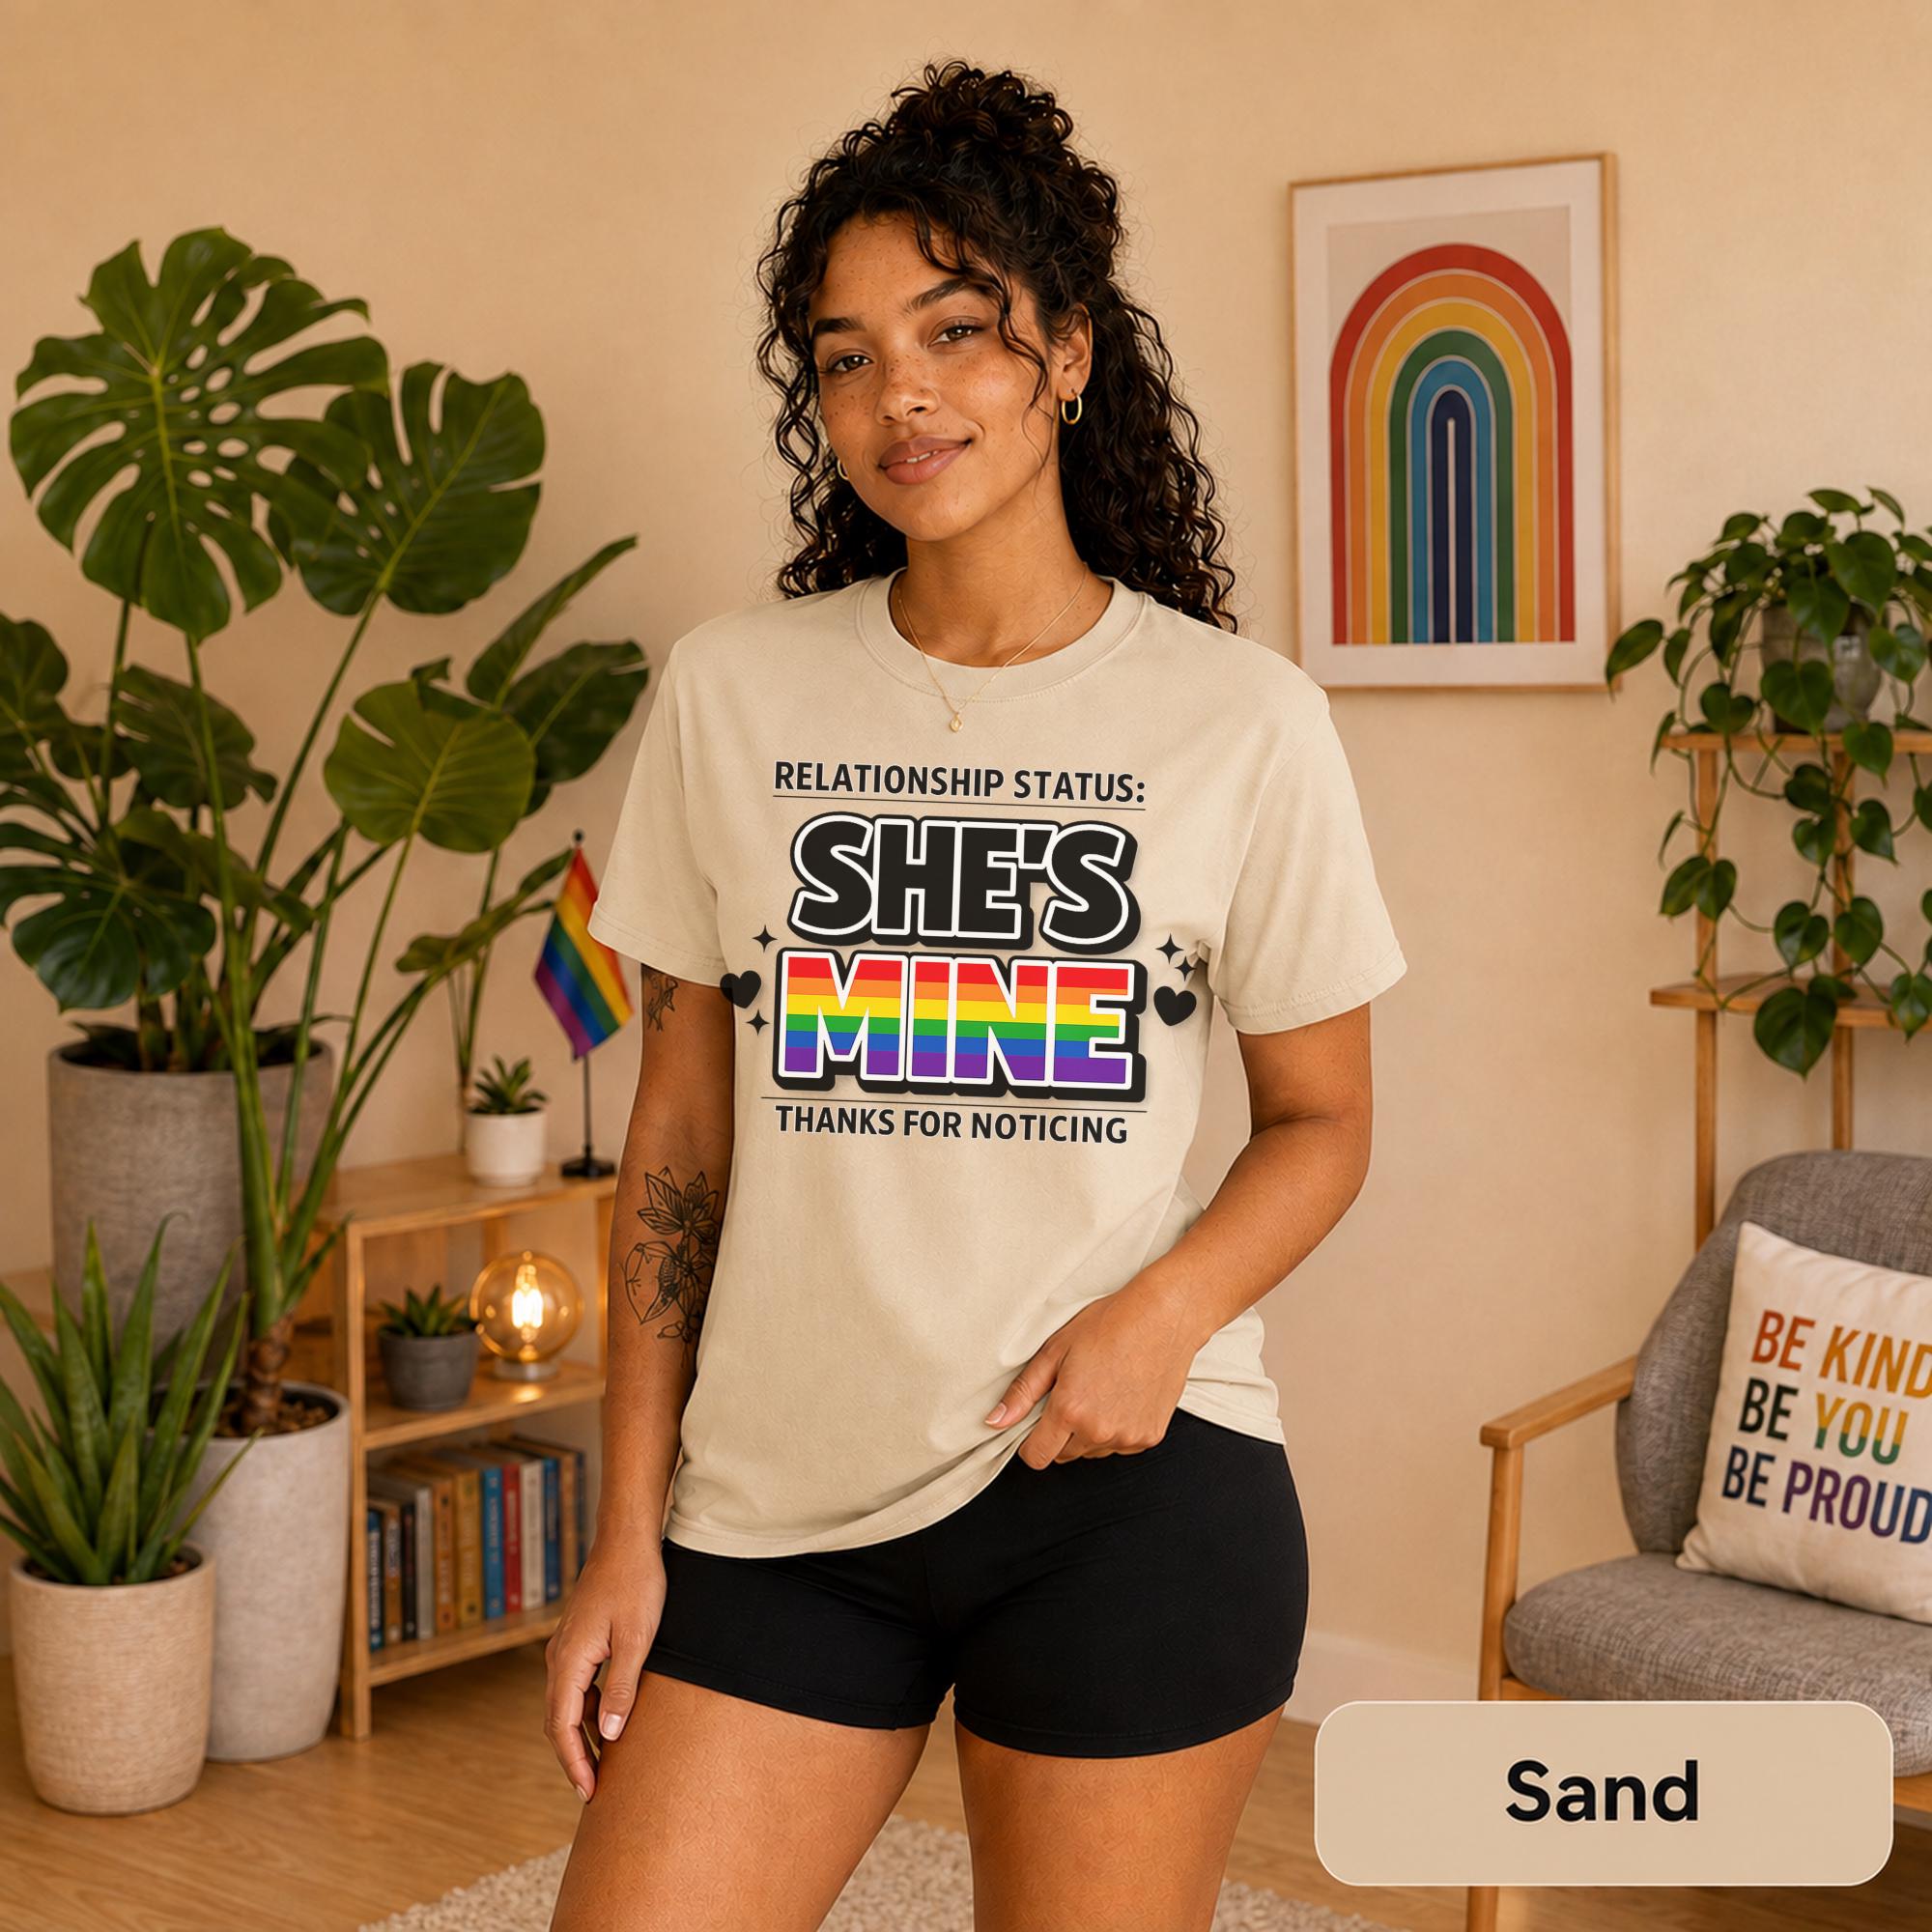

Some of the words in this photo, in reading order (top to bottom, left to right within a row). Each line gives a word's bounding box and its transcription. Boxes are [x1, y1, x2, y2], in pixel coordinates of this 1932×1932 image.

[774, 761, 1005, 797] RELATIONSHIP
[1013, 770, 1147, 803] STATUS:
[787, 811, 1141, 954] SHE'S
[773, 948, 1148, 1102] MINE
[775, 1105, 895, 1136] THANKS
[903, 1110, 961, 1138] FOR
[971, 1113, 1128, 1144] NOTICING
[1751, 1310, 1816, 1371] BE
[1819, 1325, 1932, 1399] KIND
[1739, 1378, 1799, 1441] BE
[1814, 1392, 1908, 1465] YOU
[1721, 1445, 1776, 1508] BE
[1781, 1461, 1932, 1544] PROUD
